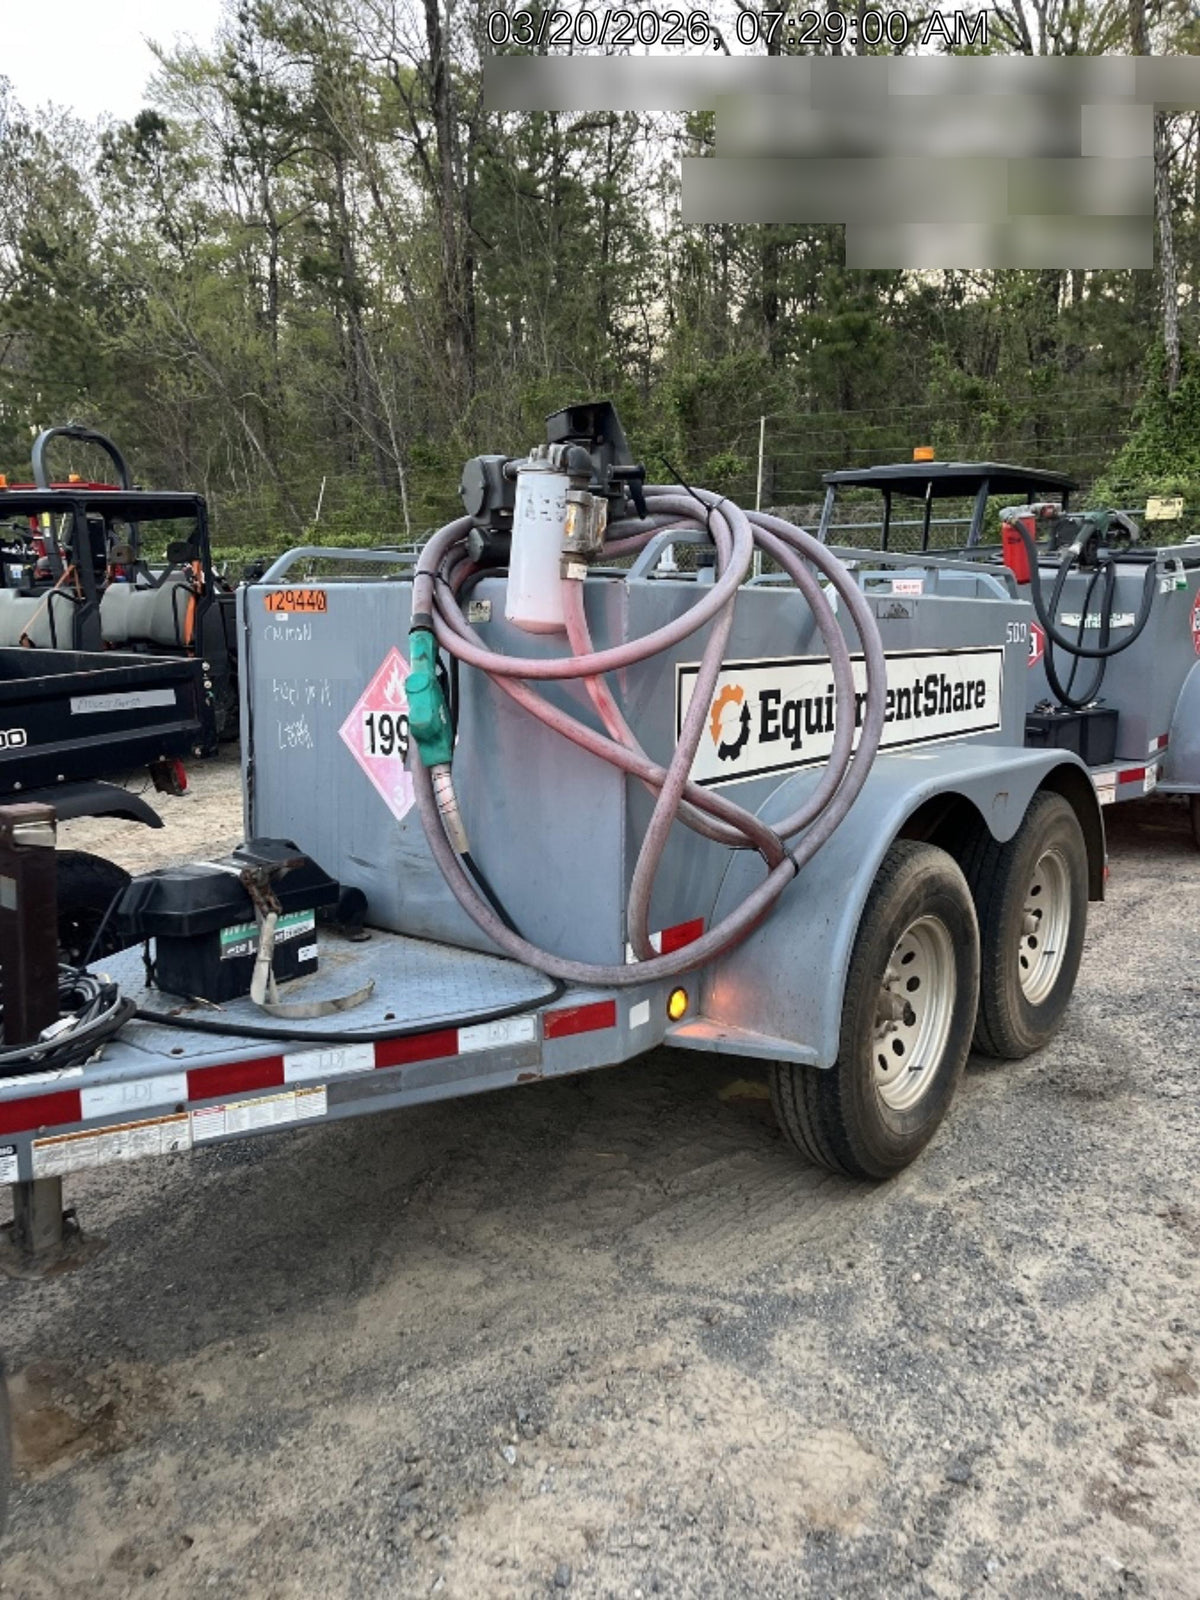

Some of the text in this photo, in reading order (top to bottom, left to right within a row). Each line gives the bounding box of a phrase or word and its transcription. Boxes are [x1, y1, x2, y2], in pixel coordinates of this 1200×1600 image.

[265, 589, 327, 611] 129440
[1006, 621, 1027, 643] 500
[758, 673, 987, 751] EquientShare
[365, 712, 410, 756] 199
[392, 784, 407, 806] 3
